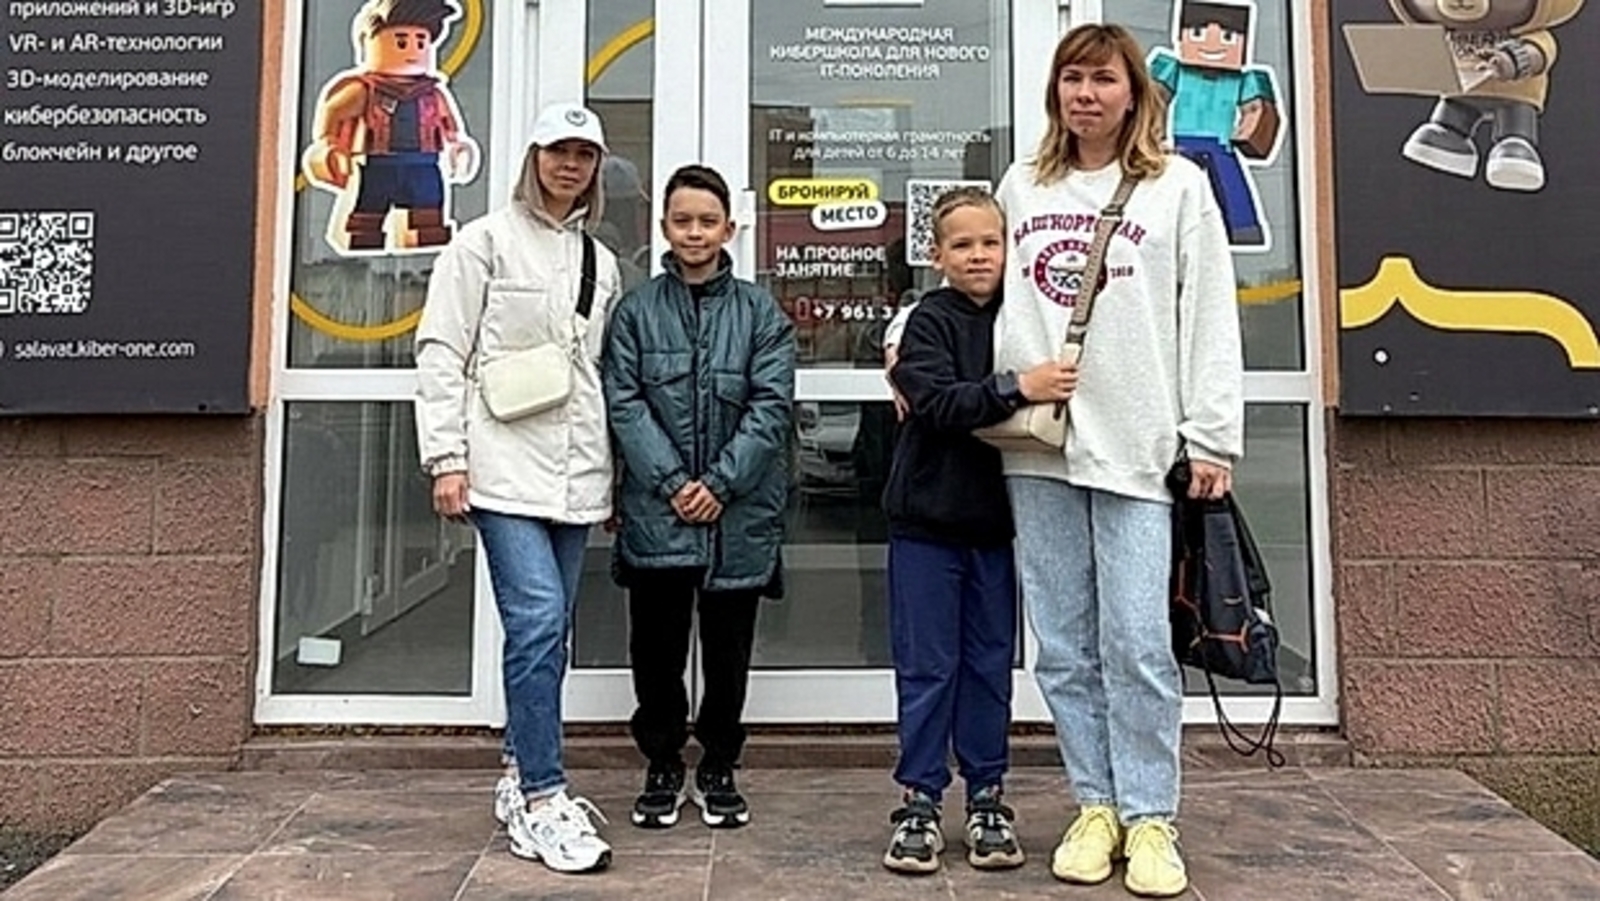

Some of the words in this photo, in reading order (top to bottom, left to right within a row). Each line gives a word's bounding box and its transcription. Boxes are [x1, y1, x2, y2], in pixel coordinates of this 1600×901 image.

[9, 0, 140, 20] приложений
[144, 1, 158, 15] и
[163, 0, 236, 19] 3D-игр
[9, 33, 46, 52] VR-
[51, 38, 65, 51] и
[69, 33, 223, 52] AR-технологии
[805, 27, 954, 42] МЕЖДУНАРОДНАЯ
[770, 45, 882, 60] КИБЕРШКОЛА
[885, 46, 921, 60] ДЛЯ
[925, 45, 990, 60] НОВОГО
[820, 63, 940, 78] IT-ПОКОЛЕНИЯ
[7, 69, 209, 91] 3D-моделирование
[4, 104, 207, 129] кибербезопасность
[785, 131, 796, 141] и
[799, 130, 900, 144] компьютерная
[902, 131, 991, 145] грамотность
[2, 142, 102, 161] блокчейн
[107, 146, 121, 160] и
[124, 144, 198, 164] другое
[793, 147, 821, 160] для
[822, 146, 864, 159] детей
[777, 183, 871, 200] БРОНИРУЙ
[819, 206, 879, 224] МЕСТО
[775, 246, 801, 261] НА
[804, 246, 886, 262] ПРОБНОЕ
[775, 263, 854, 278] ЗАНЯТИЕ
[813, 305, 835, 319] +7
[840, 304, 876, 320] 961
[881, 305, 894, 320] 3
[15, 340, 195, 359] salavat.kiber-one.com
